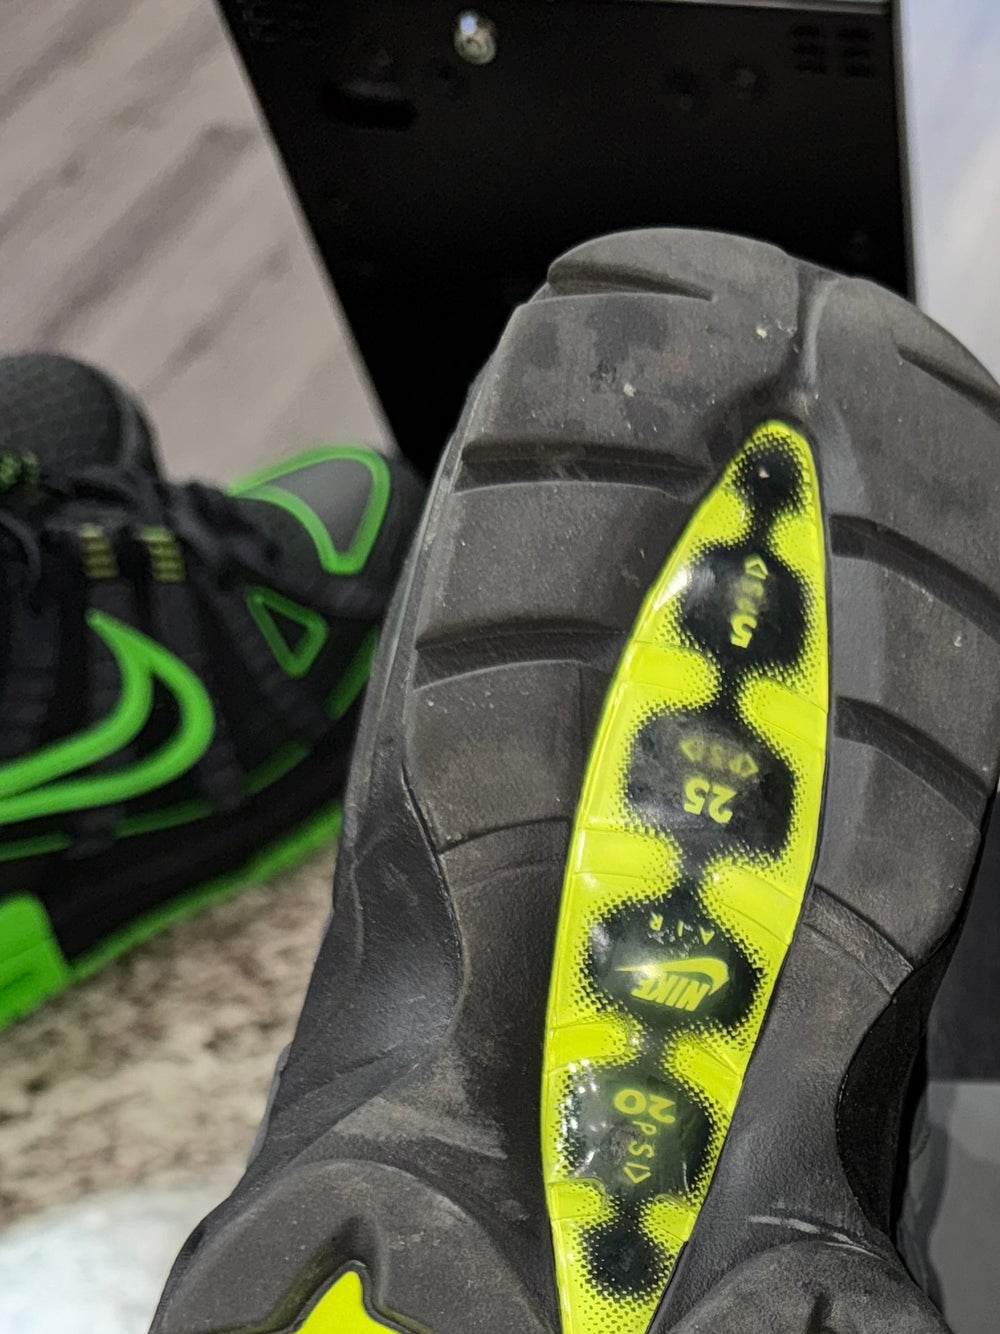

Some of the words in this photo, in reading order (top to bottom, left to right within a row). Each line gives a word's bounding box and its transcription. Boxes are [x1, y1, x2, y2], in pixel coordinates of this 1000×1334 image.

[731, 614, 757, 649] 5
[684, 777, 737, 824] 25
[649, 911, 715, 946] AIR
[630, 972, 711, 1012] NIKE
[613, 1087, 677, 1124] 20
